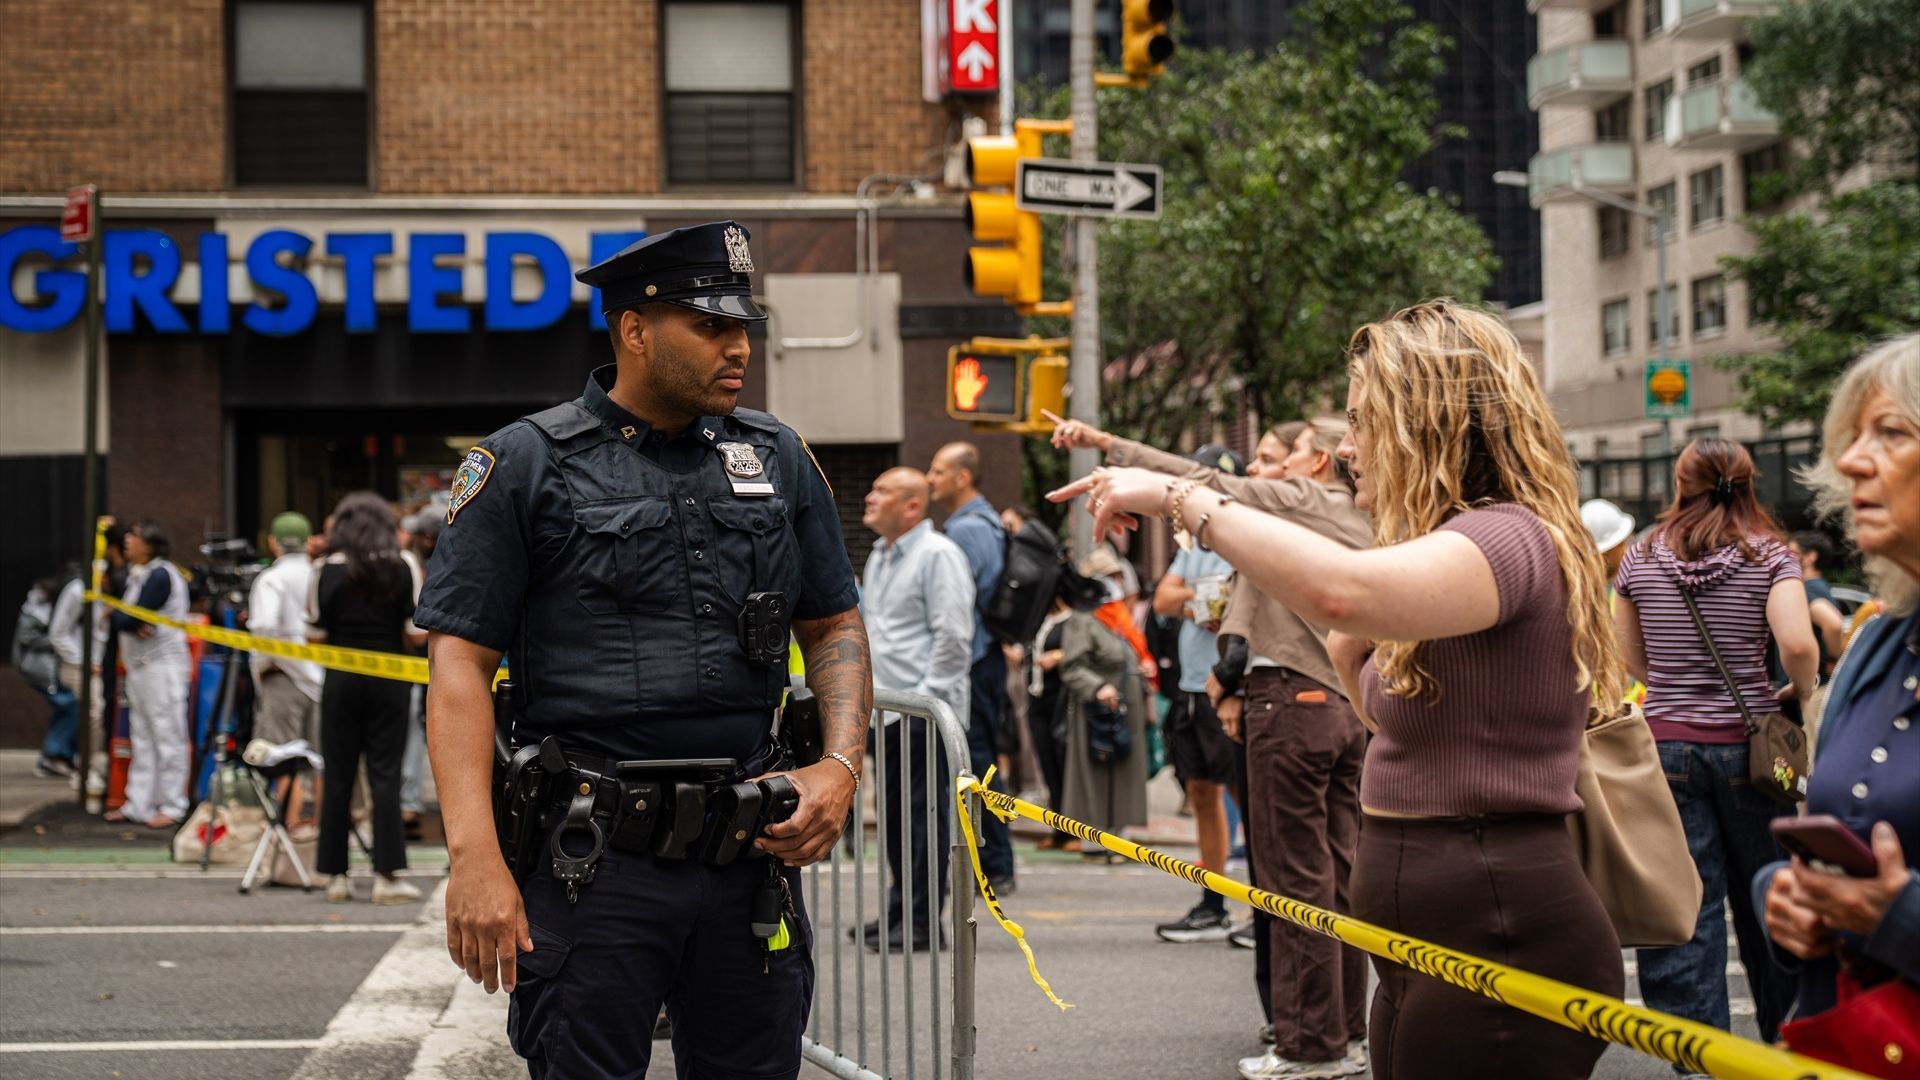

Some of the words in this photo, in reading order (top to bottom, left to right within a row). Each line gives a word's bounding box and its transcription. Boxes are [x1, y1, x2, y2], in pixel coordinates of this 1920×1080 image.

[953, 0, 997, 33] K
[1033, 174, 1069, 197] ONE
[1089, 178, 1130, 199] WAY
[466, 451, 483, 462] OLICE
[463, 480, 482, 499] YORK
[1388, 939, 1508, 1004] CAUTION
[1564, 998, 1712, 1075] CAUTION
